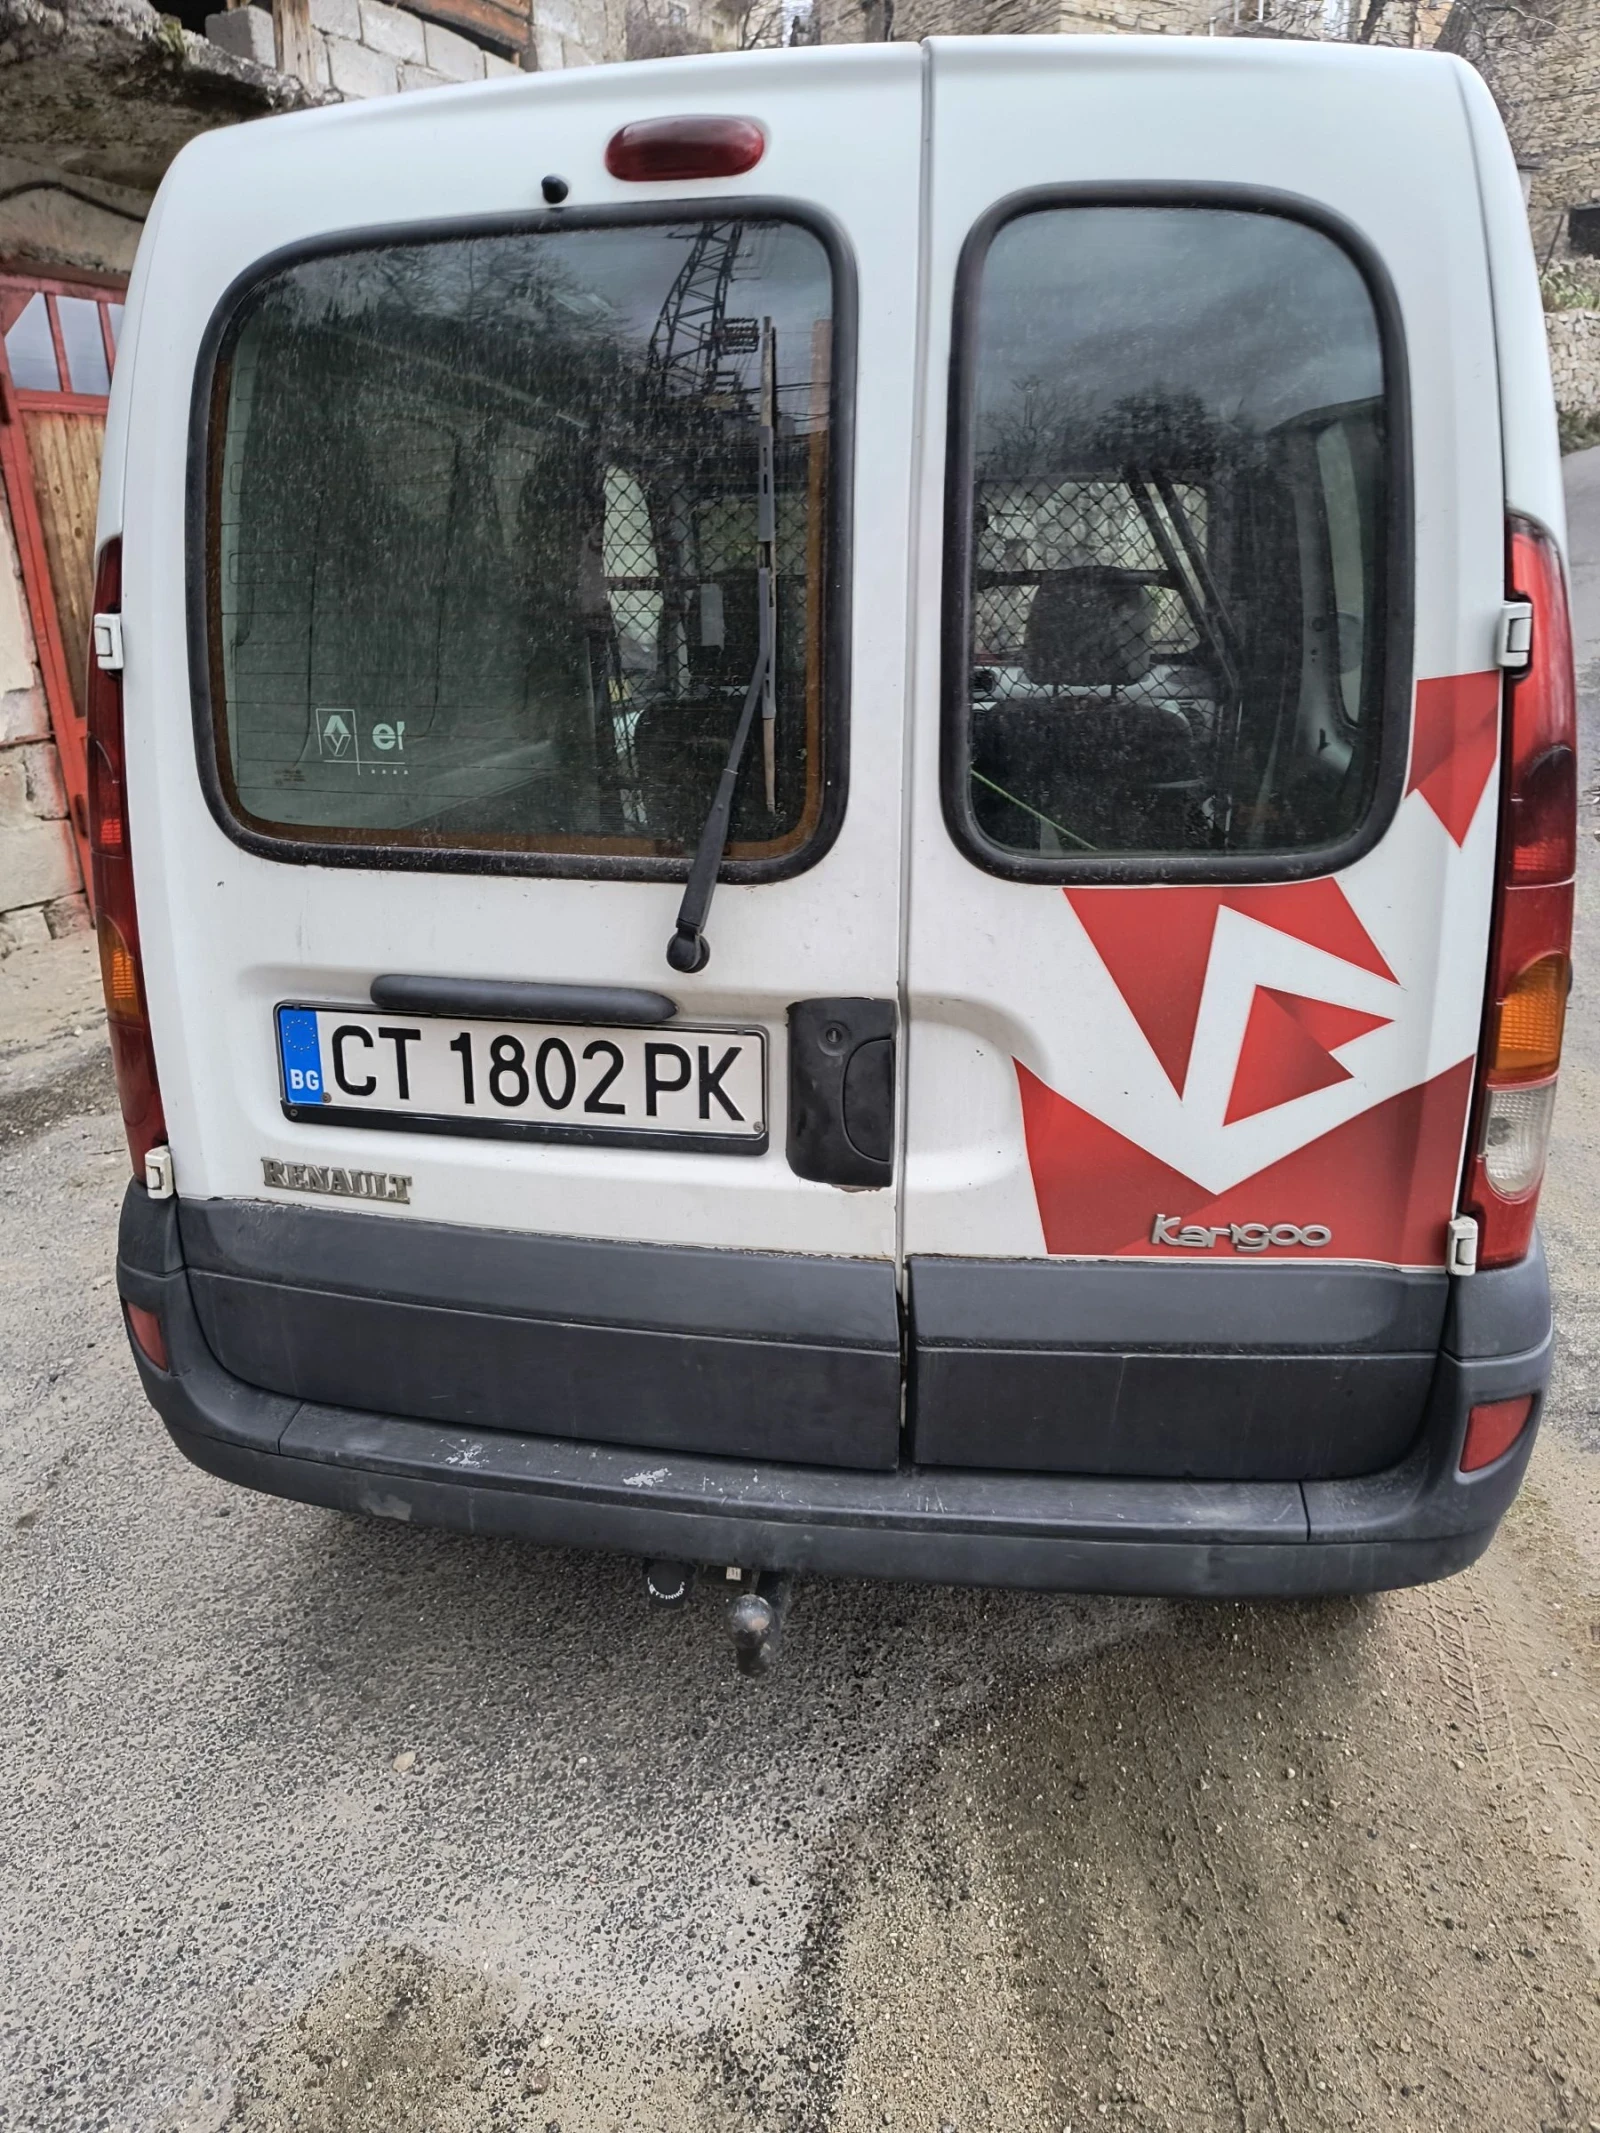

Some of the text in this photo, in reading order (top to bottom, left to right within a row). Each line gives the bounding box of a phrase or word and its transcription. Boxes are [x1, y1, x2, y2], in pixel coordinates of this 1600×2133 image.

[290, 1068, 320, 1092] BG
[331, 1024, 747, 1122] CT 1802 PK
[260, 1156, 413, 1205] RENAULT
